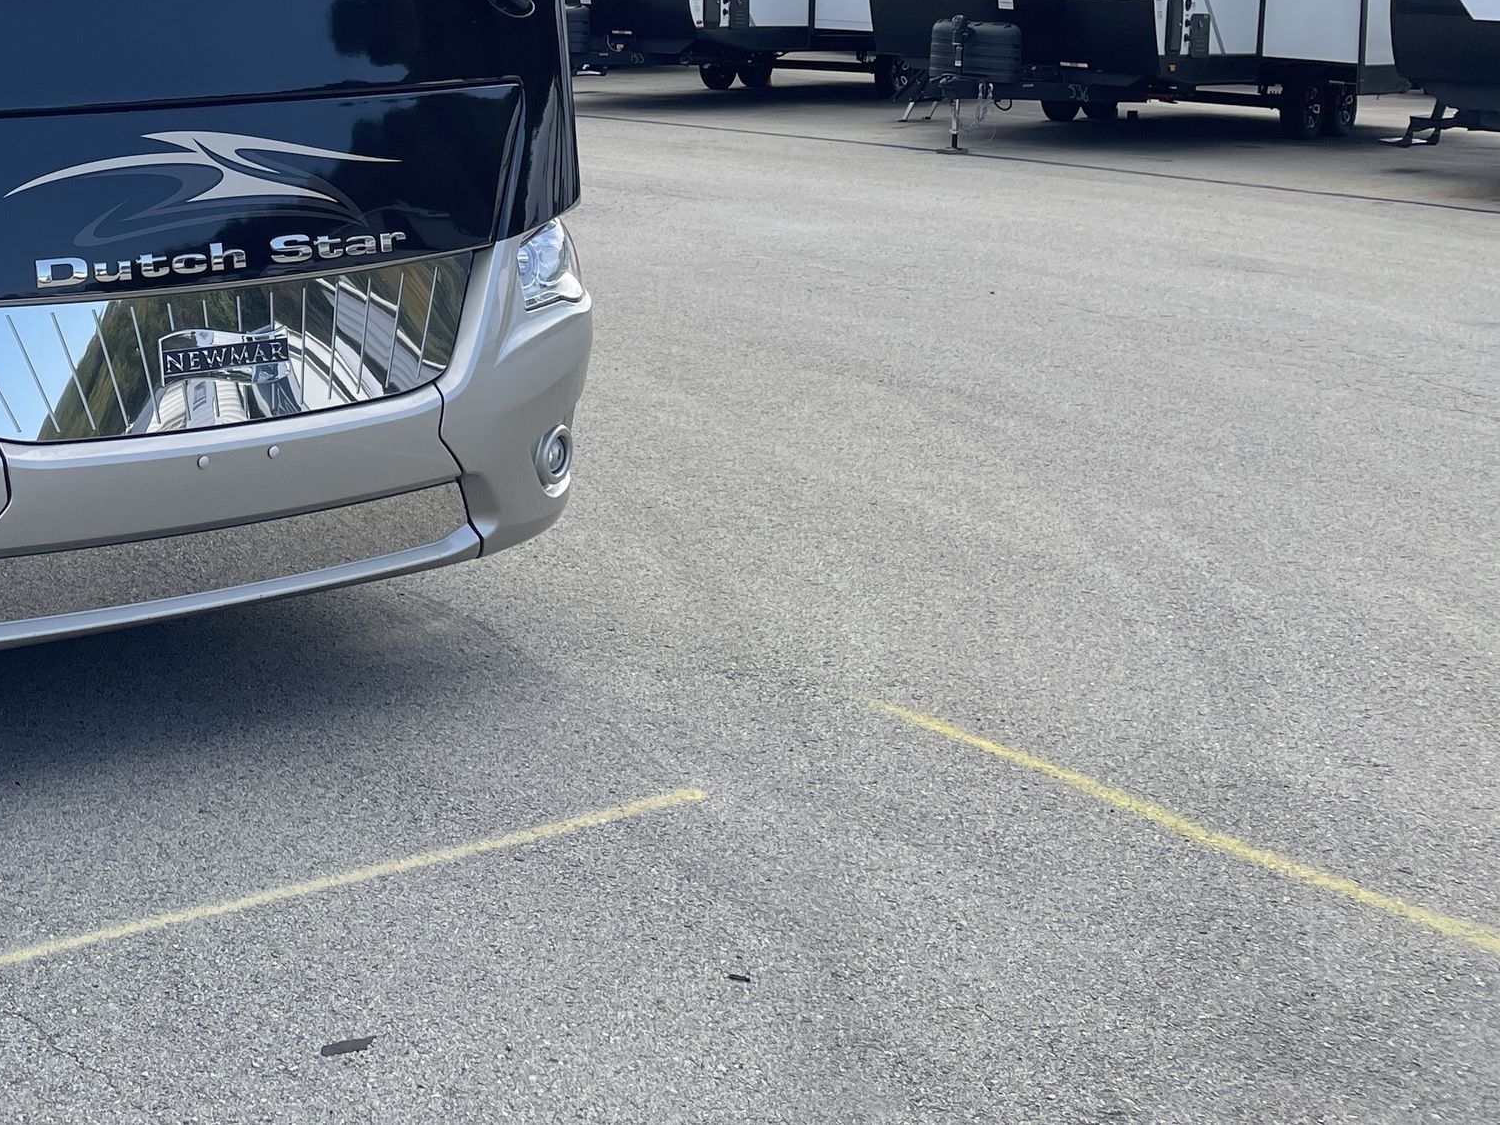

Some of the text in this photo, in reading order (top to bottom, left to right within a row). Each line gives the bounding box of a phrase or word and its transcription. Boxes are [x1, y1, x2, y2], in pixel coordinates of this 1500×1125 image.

[34, 230, 407, 289] Dutch Star
[164, 340, 288, 375] NEWMAR
